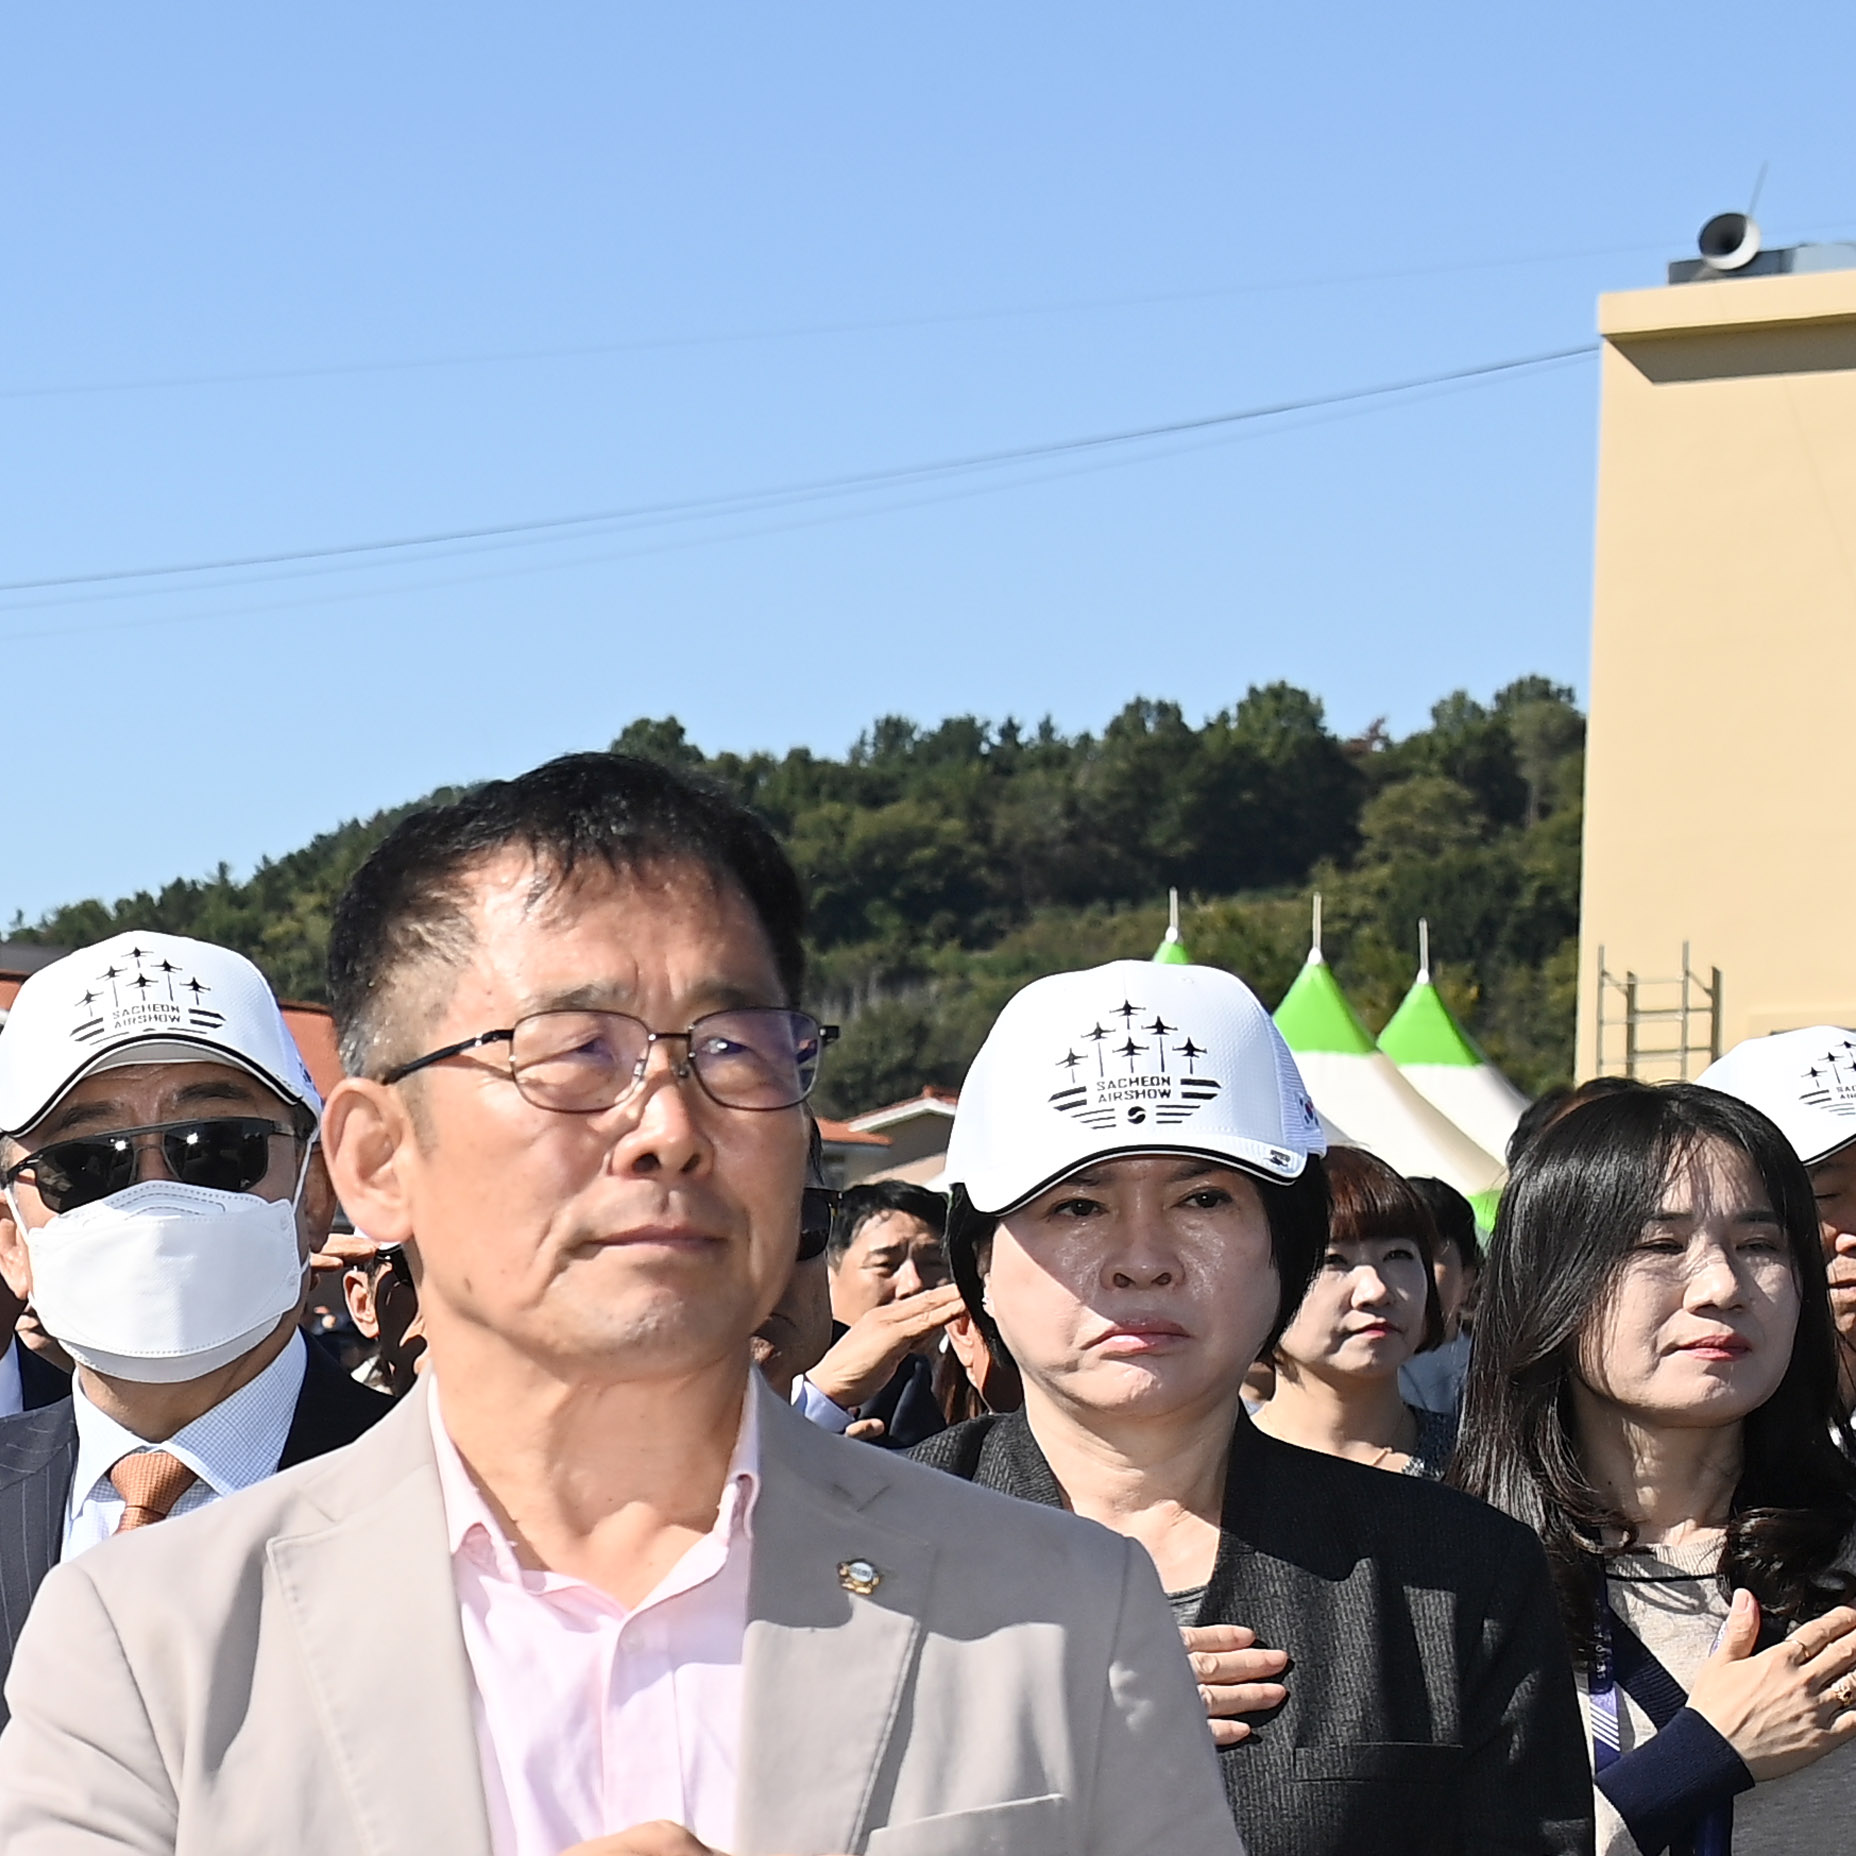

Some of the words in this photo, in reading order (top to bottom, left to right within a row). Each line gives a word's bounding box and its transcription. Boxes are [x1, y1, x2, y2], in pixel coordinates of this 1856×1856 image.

[111, 1004, 181, 1020] SACHEON
[114, 1014, 182, 1029] AIRSHOW
[1095, 1075, 1172, 1091] SACHEON
[1097, 1088, 1172, 1103] AIRSHOW
